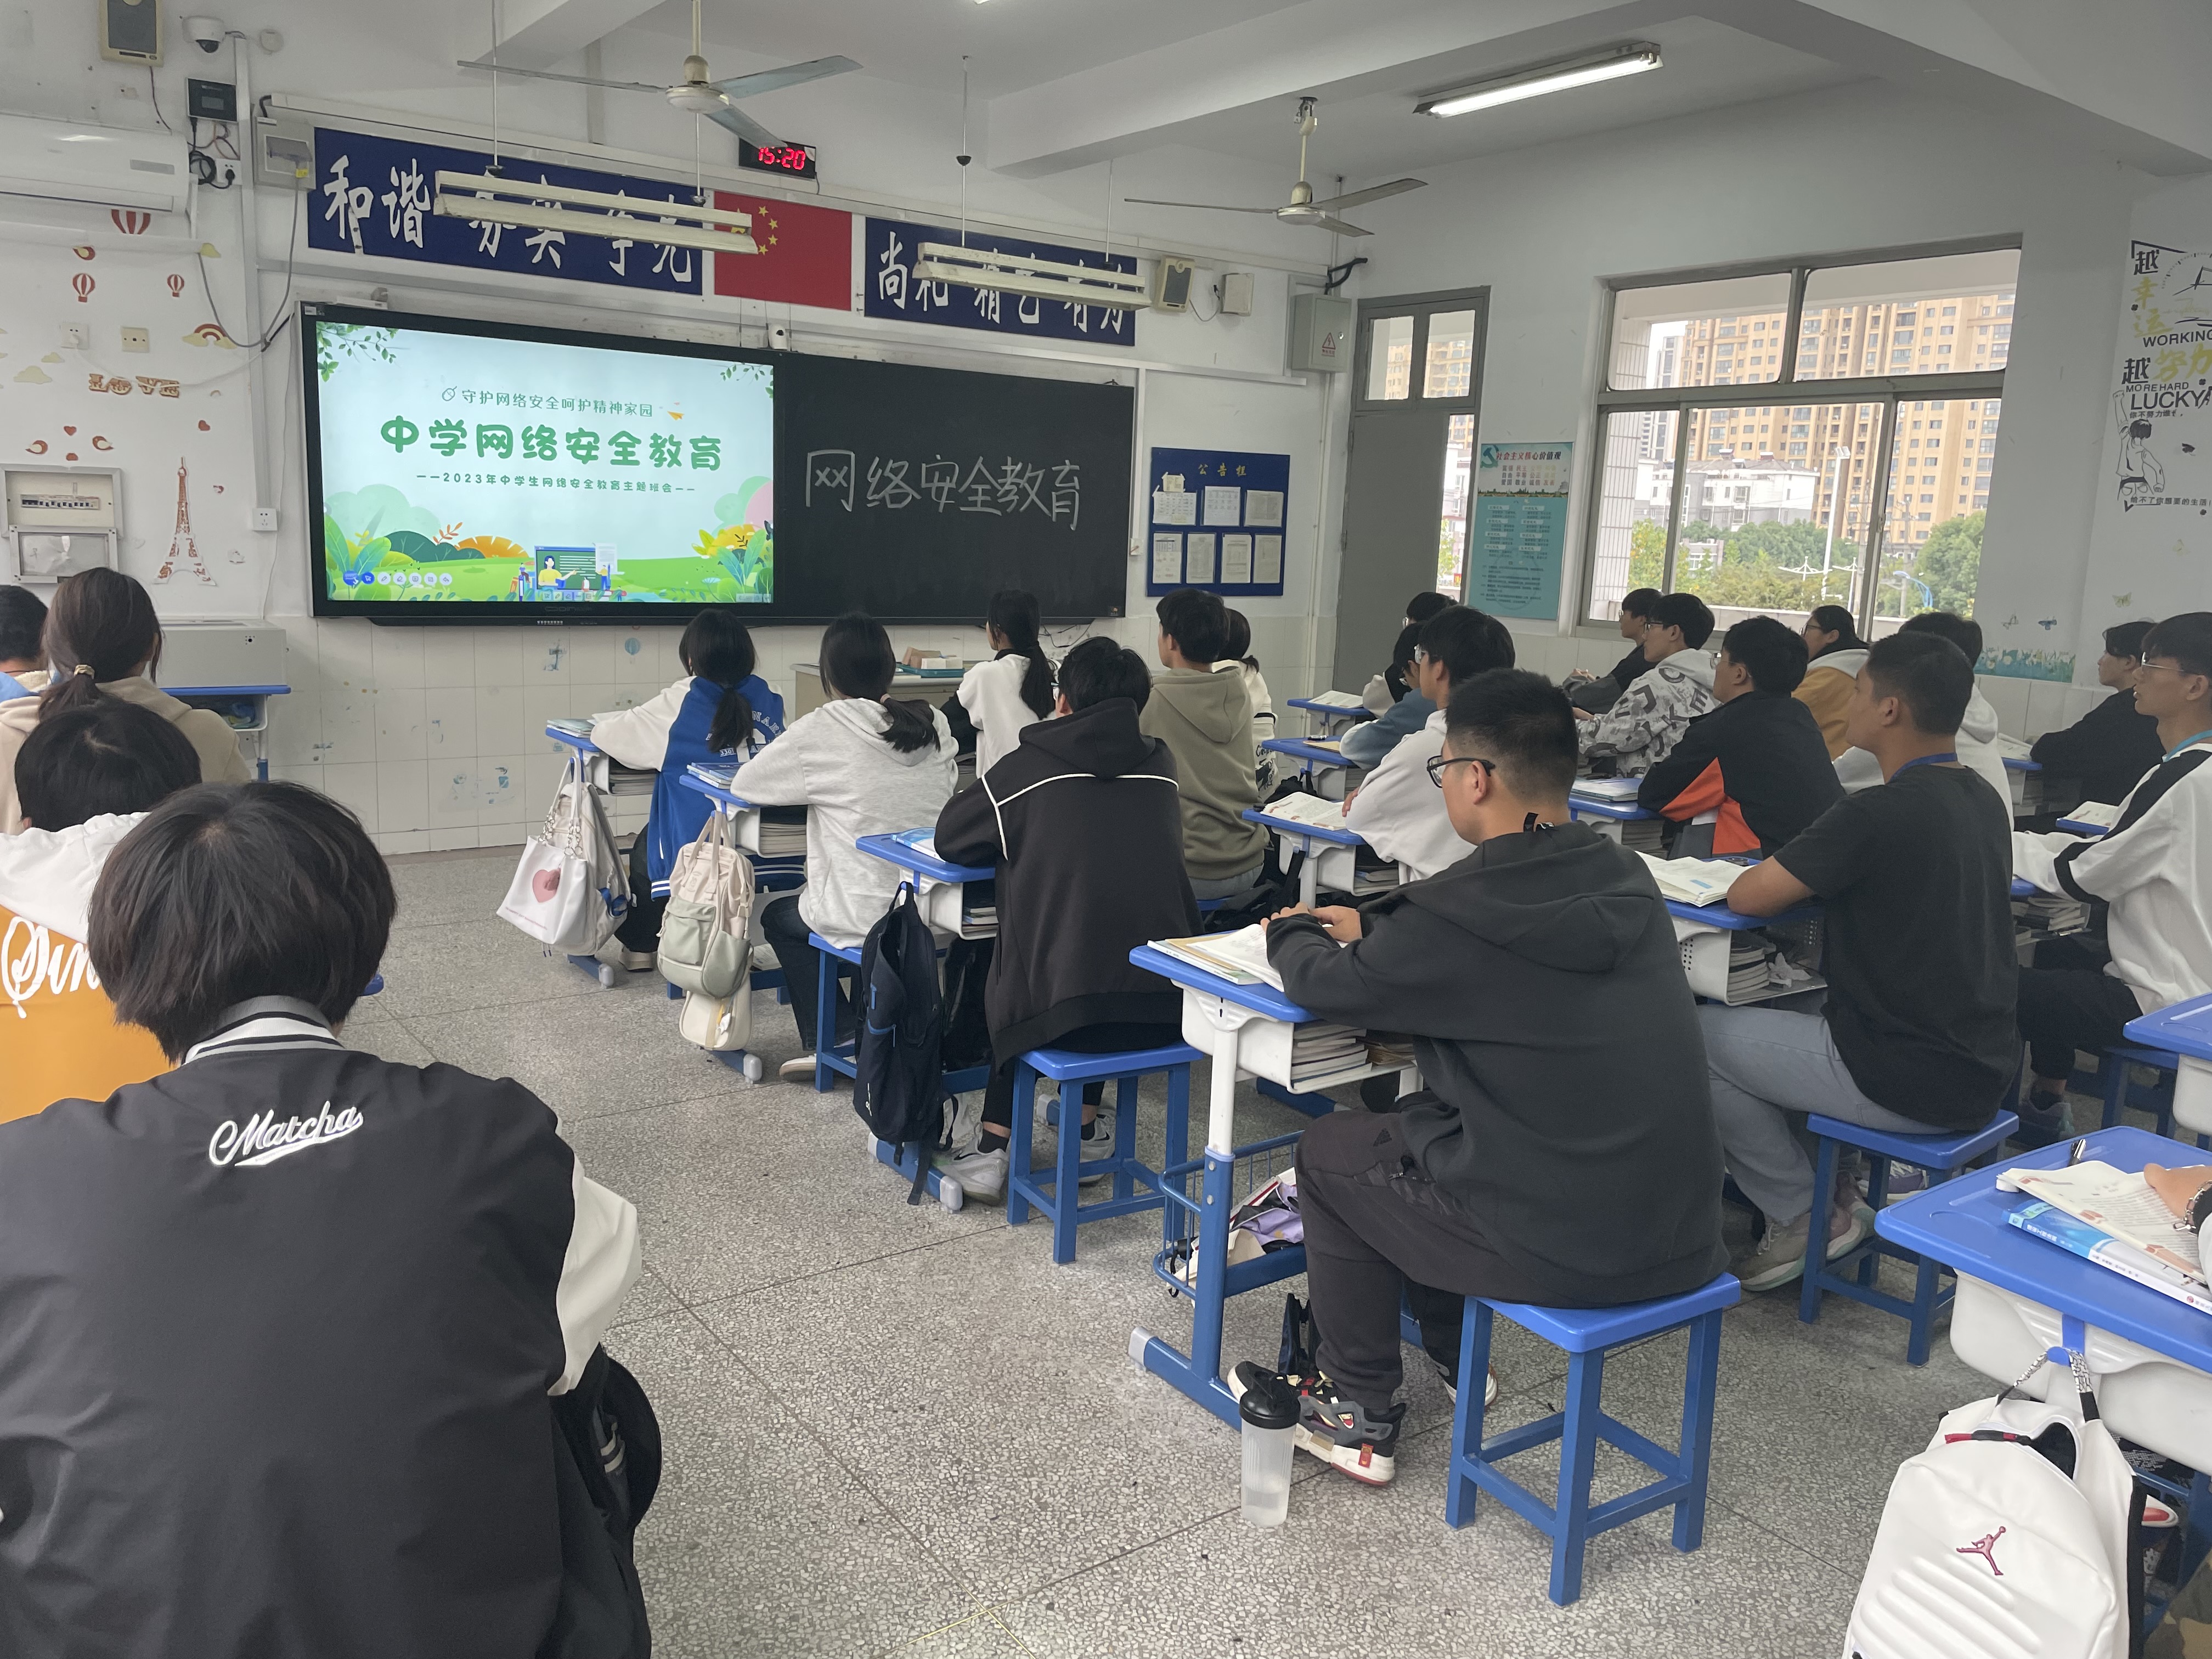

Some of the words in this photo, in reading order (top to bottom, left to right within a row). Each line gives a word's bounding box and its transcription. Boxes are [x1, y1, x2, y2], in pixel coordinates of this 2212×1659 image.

[758, 146, 806, 171] 15:20
[324, 154, 431, 249] 和谐
[89, 374, 179, 398] LOVE
[2159, 382, 2189, 391] HARD
[462, 389, 653, 417] 守护网络安全呵护精神家园
[2131, 390, 2206, 410] LUCKY
[380, 415, 722, 471] 中学网络安全教育
[1496, 451, 1561, 460] 社会主义核心价值观
[805, 449, 1081, 531] 网络安全教育
[209, 1101, 363, 1166] Matcha
